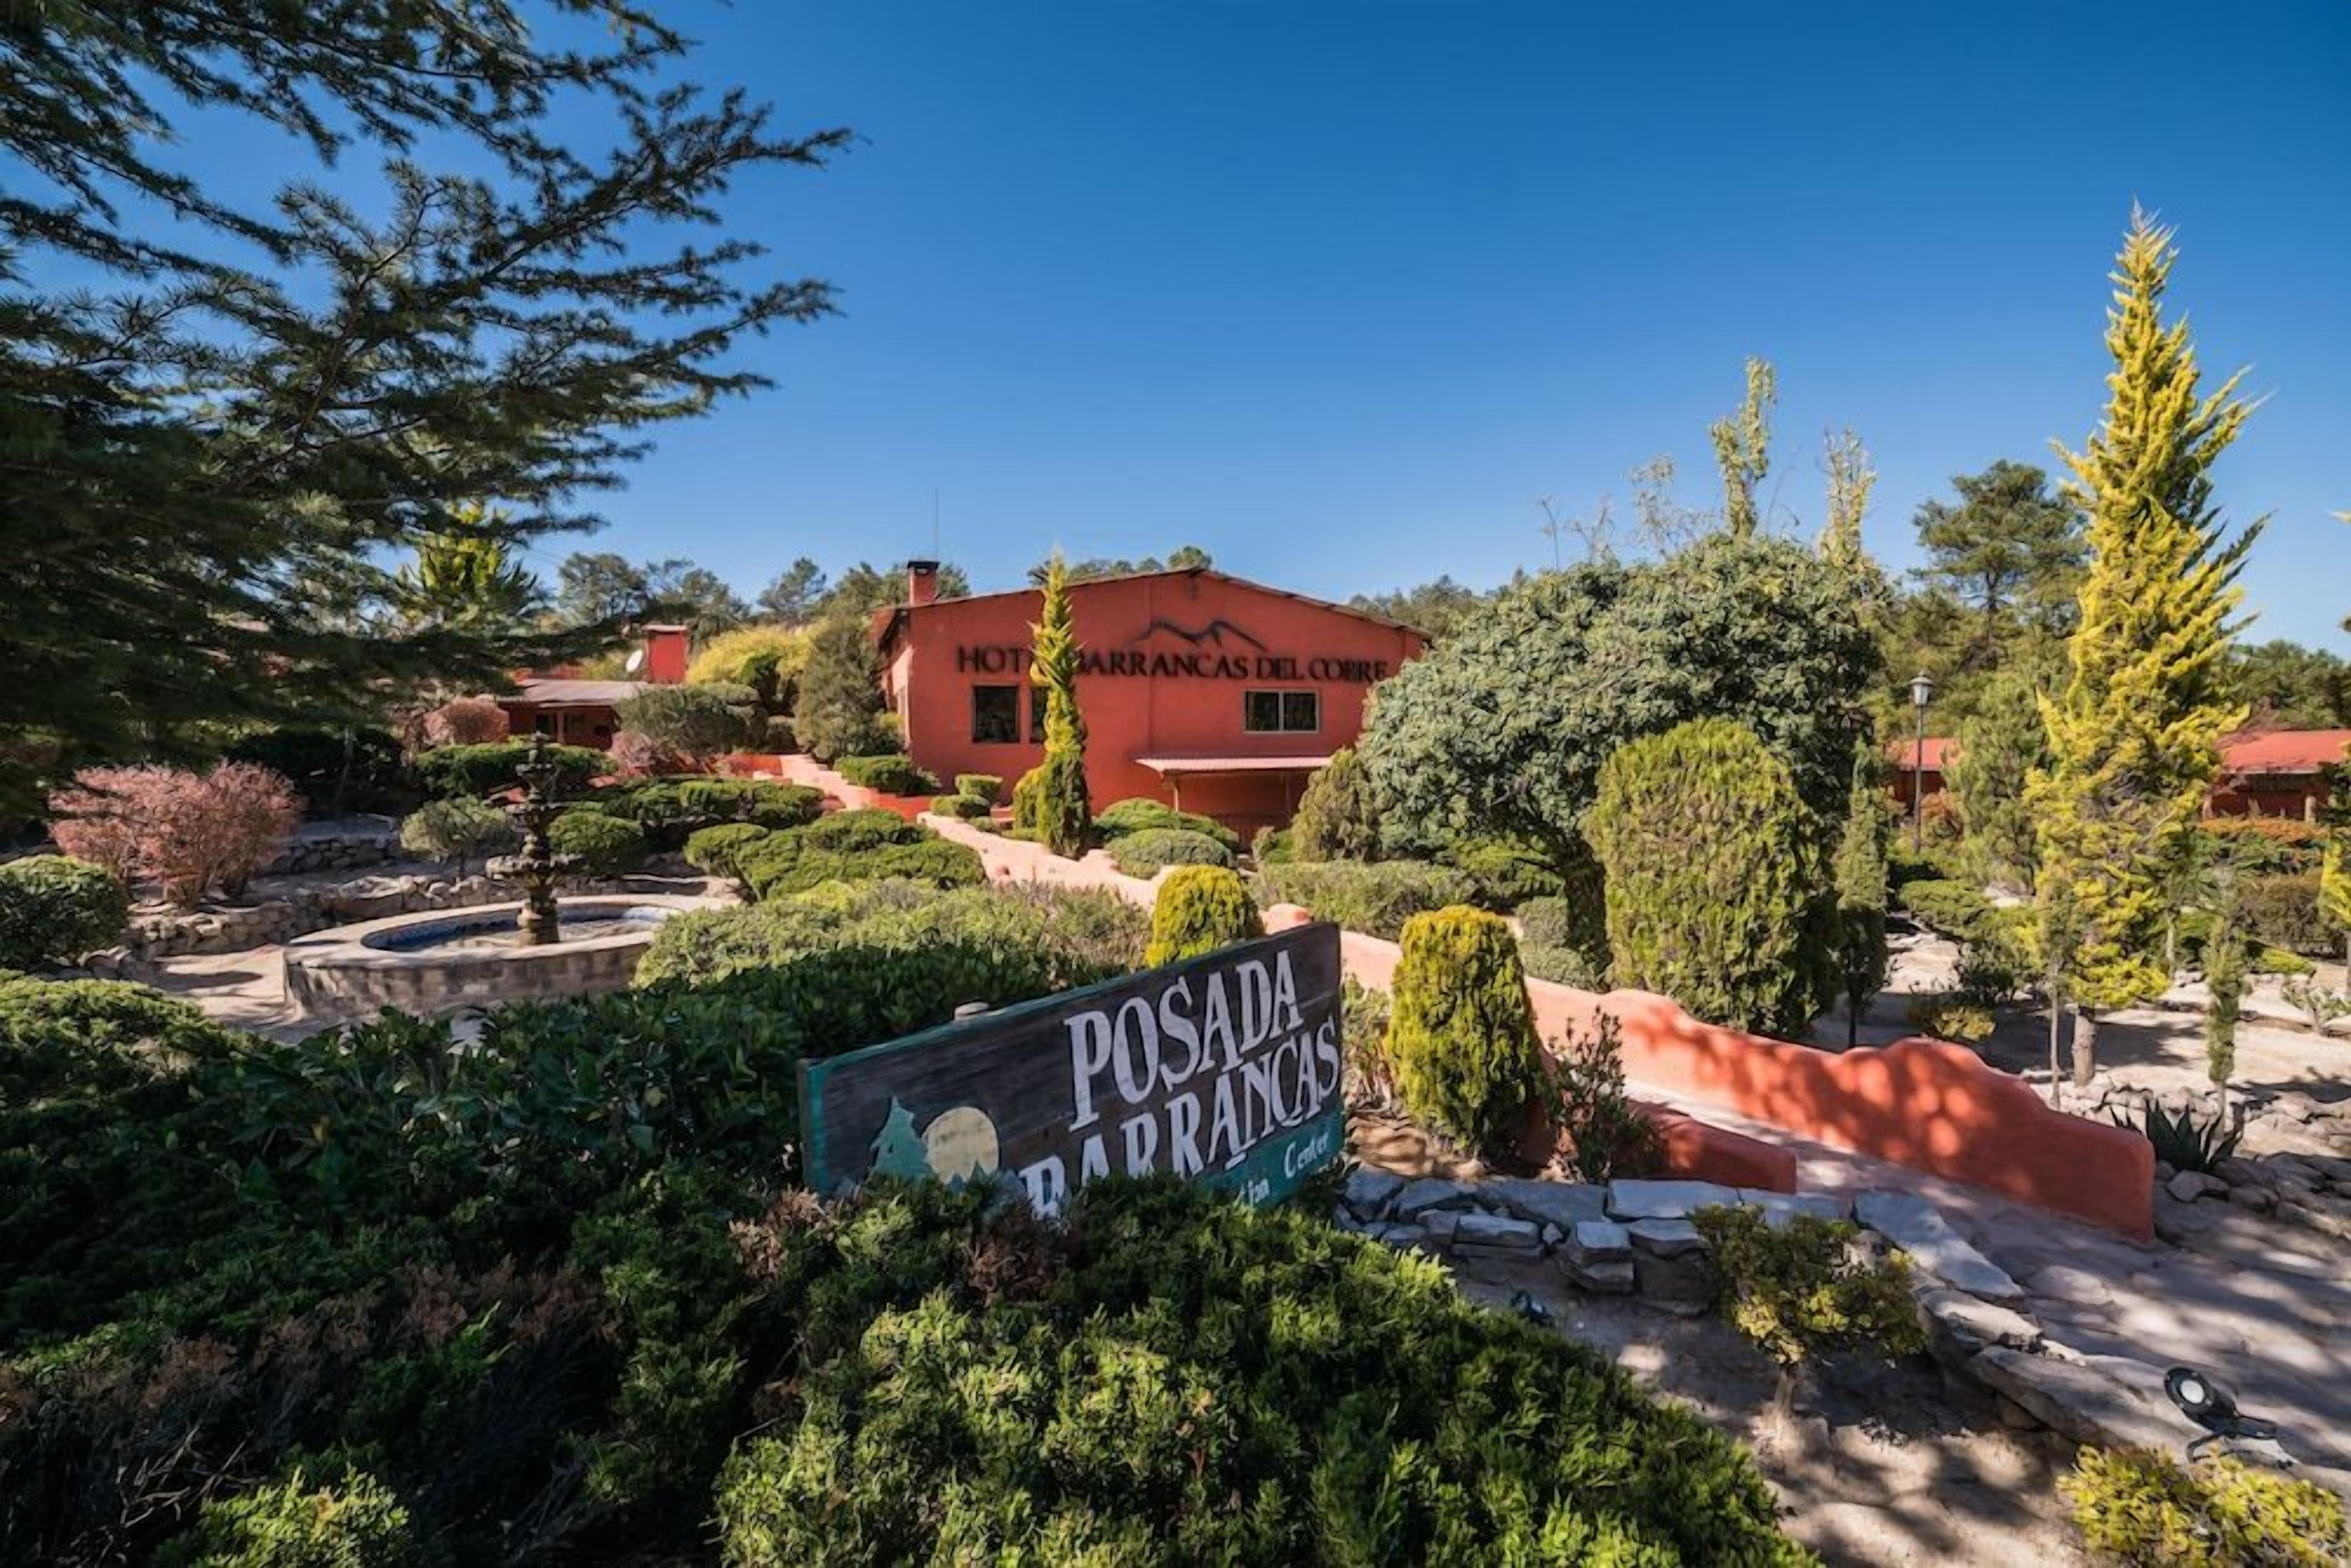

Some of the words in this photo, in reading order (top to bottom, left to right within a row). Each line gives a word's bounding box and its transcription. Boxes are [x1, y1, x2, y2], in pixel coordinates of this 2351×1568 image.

[958, 645, 1034, 674] HOT
[1257, 657, 1305, 679] DEL
[1308, 657, 1388, 683] COBRE
[1019, 1016, 1338, 1221] BARRANCAS
[1064, 950, 1303, 1133] POSADA
